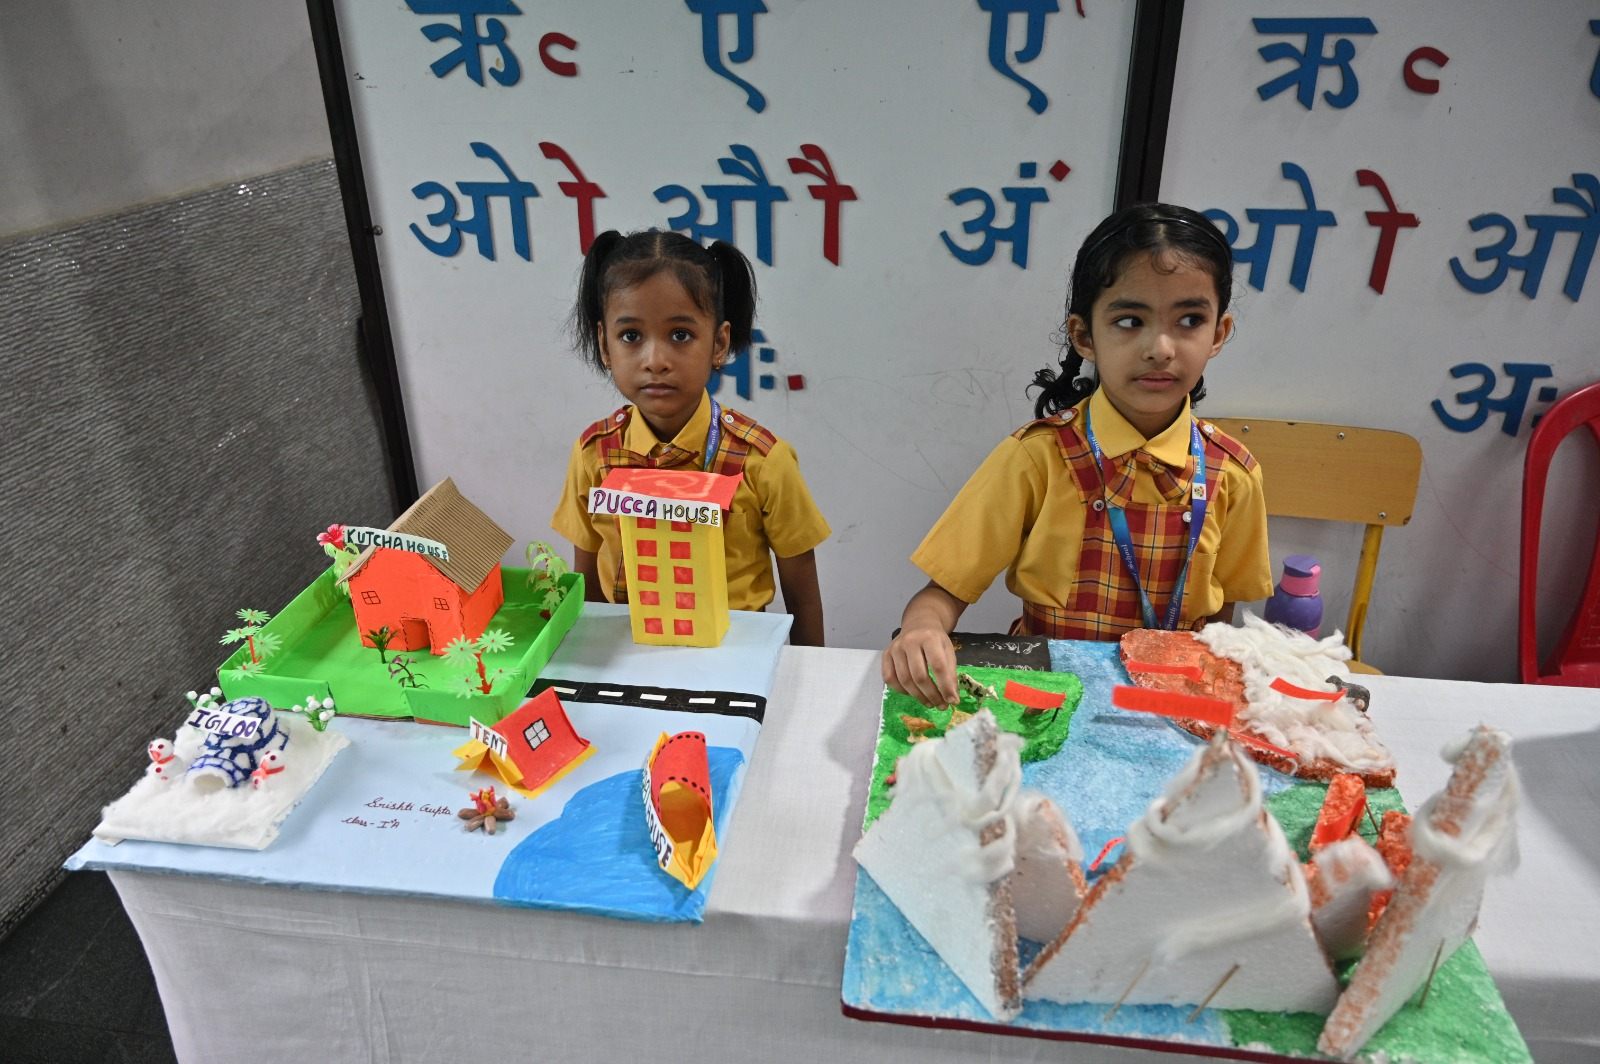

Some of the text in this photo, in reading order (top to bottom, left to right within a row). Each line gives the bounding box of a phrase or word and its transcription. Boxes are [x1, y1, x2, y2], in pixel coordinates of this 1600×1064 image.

[409, 142, 541, 262] ओ
[593, 489, 719, 525] PUCCA HOUSE
[346, 528, 448, 560] KUTCHA HOUSE
[188, 709, 257, 737] IGLOO
[472, 720, 507, 757] TENT
